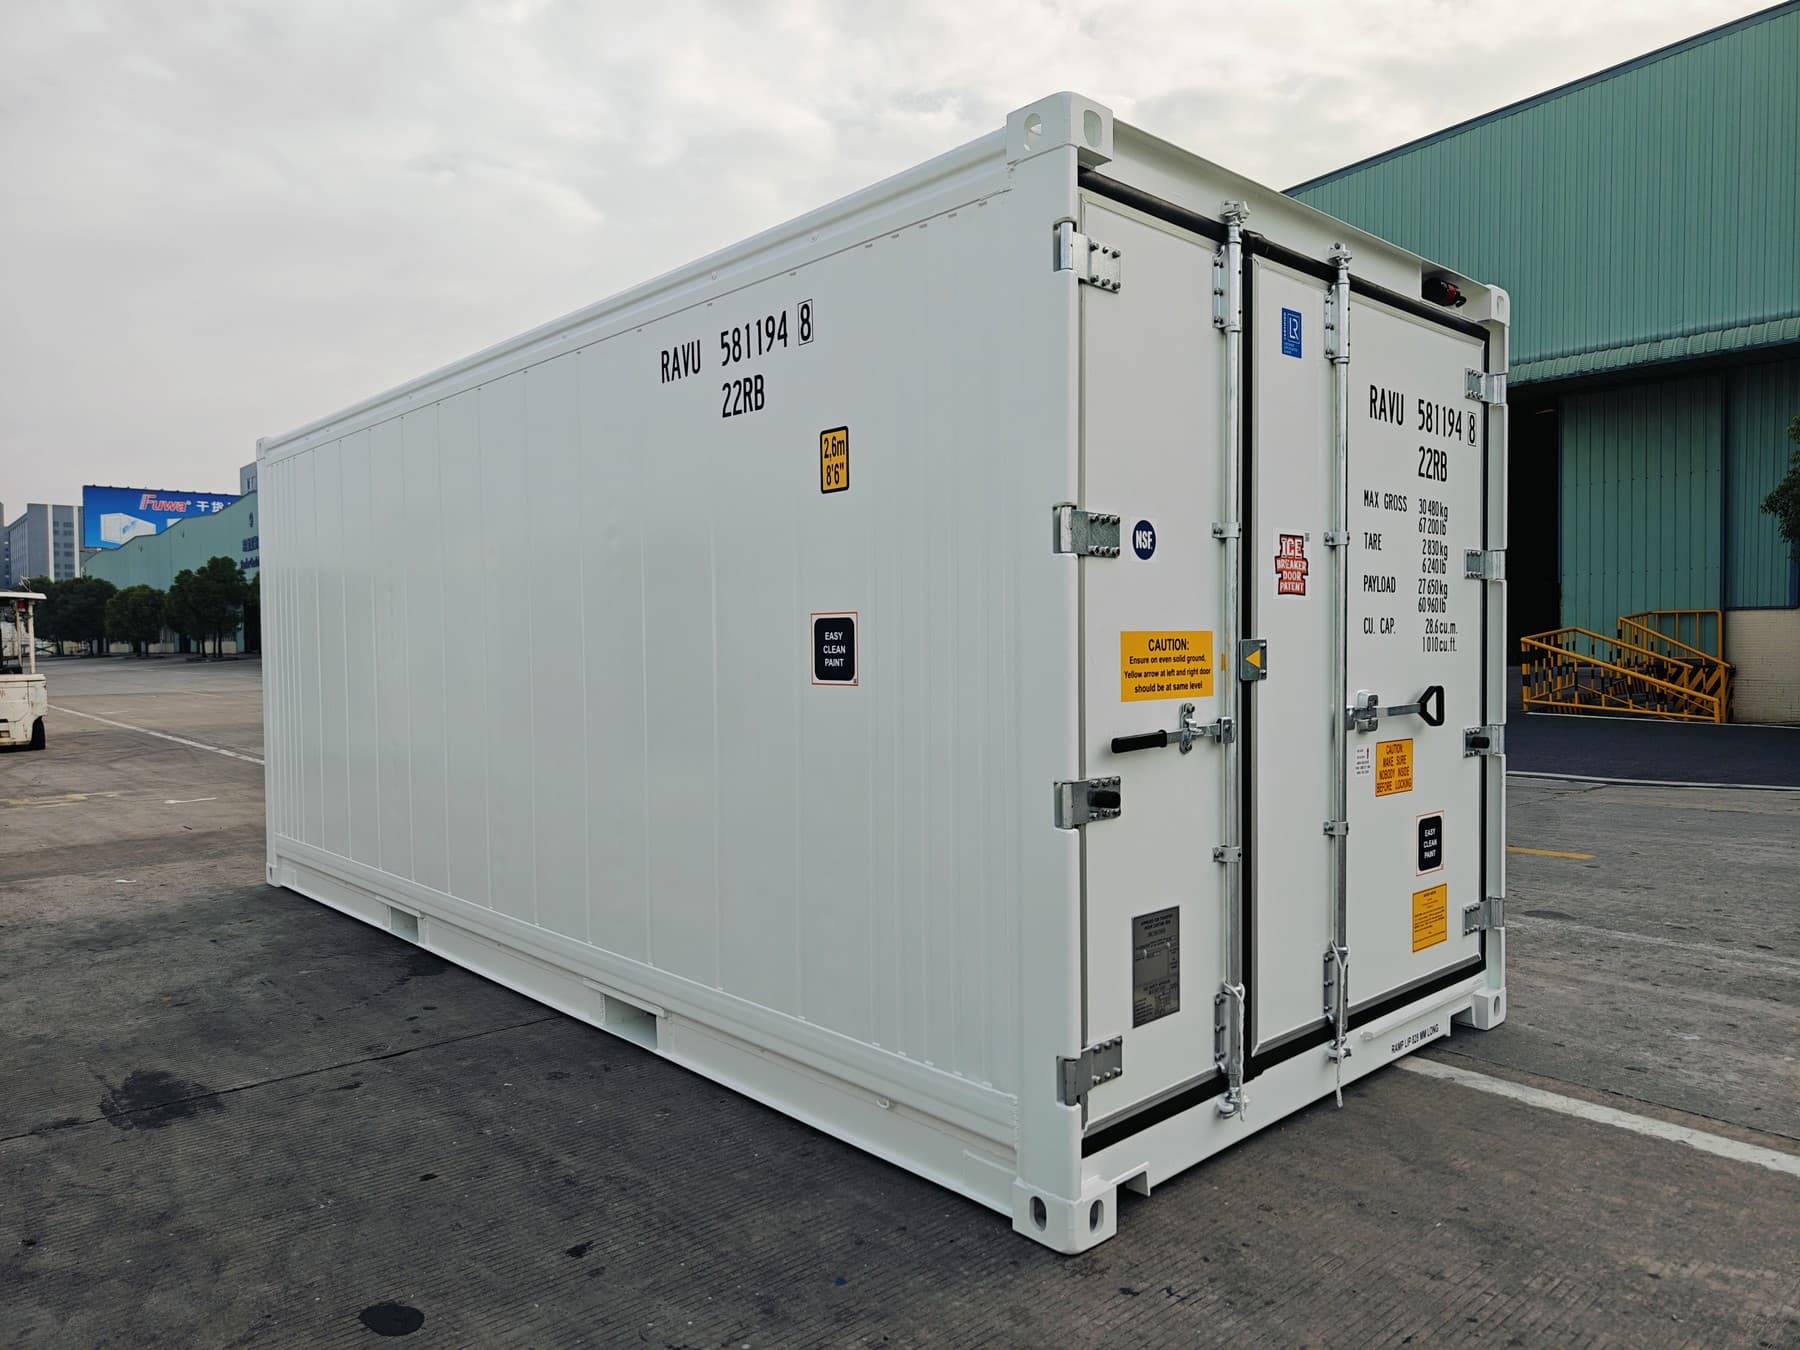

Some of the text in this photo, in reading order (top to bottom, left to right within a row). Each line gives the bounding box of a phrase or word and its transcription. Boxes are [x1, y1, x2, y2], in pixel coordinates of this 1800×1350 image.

[661, 303, 812, 384] RAVU 581194 8
[722, 374, 765, 418] 22RB
[1369, 384, 1476, 444] RAVU 581194 8
[1418, 445, 1448, 482] 22RB
[1363, 489, 1379, 509] MAX
[1383, 492, 1408, 512] GROSS
[1135, 529, 1153, 550] NSF
[1363, 531, 1382, 551] TARE
[1281, 537, 1303, 559] ICE
[1282, 570, 1302, 581] DOOR
[1280, 581, 1304, 593] PATENT
[1363, 574, 1396, 593] PAYLOAD
[1363, 617, 1376, 634] CU.
[1380, 617, 1396, 634] CAP.
[824, 631, 843, 641] EASY
[822, 645, 846, 655] CLEAN
[1147, 638, 1190, 652] CAUTION:
[824, 658, 844, 667] PAINT
[1129, 656, 1150, 665] Ensure
[1173, 654, 1186, 663] solid
[1123, 670, 1143, 679] Yellow
[1143, 670, 1159, 678] arrow
[1166, 668, 1176, 677] left
[1176, 668, 1186, 676] and
[1186, 668, 1199, 678] right
[1134, 685, 1156, 693] should
[1156, 684, 1165, 692] be
[1165, 683, 1172, 691] at
[1189, 680, 1203, 689] level
[1424, 828, 1436, 837] EASY
[1423, 839, 1438, 849] CLEAN
[1424, 849, 1436, 859] PAINT
